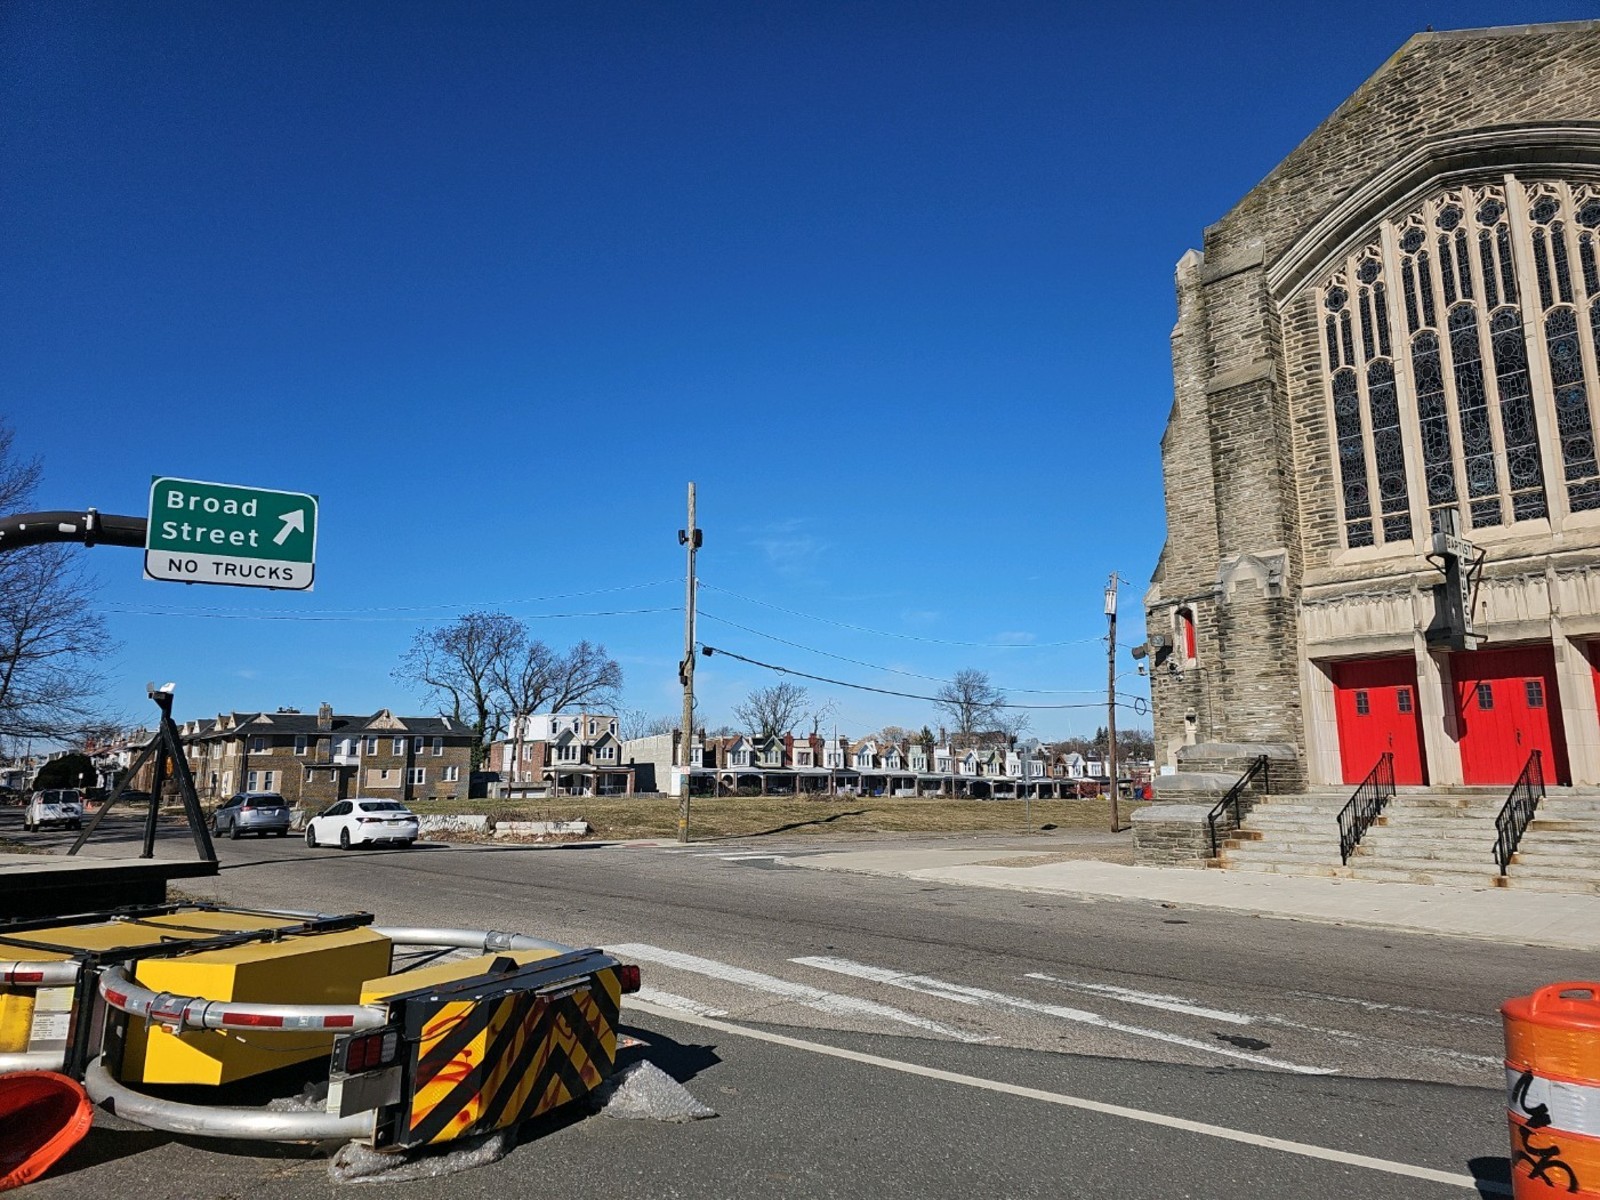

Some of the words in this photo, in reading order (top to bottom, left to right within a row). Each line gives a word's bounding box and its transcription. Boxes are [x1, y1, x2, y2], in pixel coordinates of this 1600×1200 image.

[167, 490, 258, 517] Broad
[161, 521, 259, 547] Street
[1446, 537, 1471, 556] BAPTIST
[168, 558, 198, 573] NO
[212, 561, 294, 581] TRUCKS
[1460, 555, 1472, 629] CHURCH
